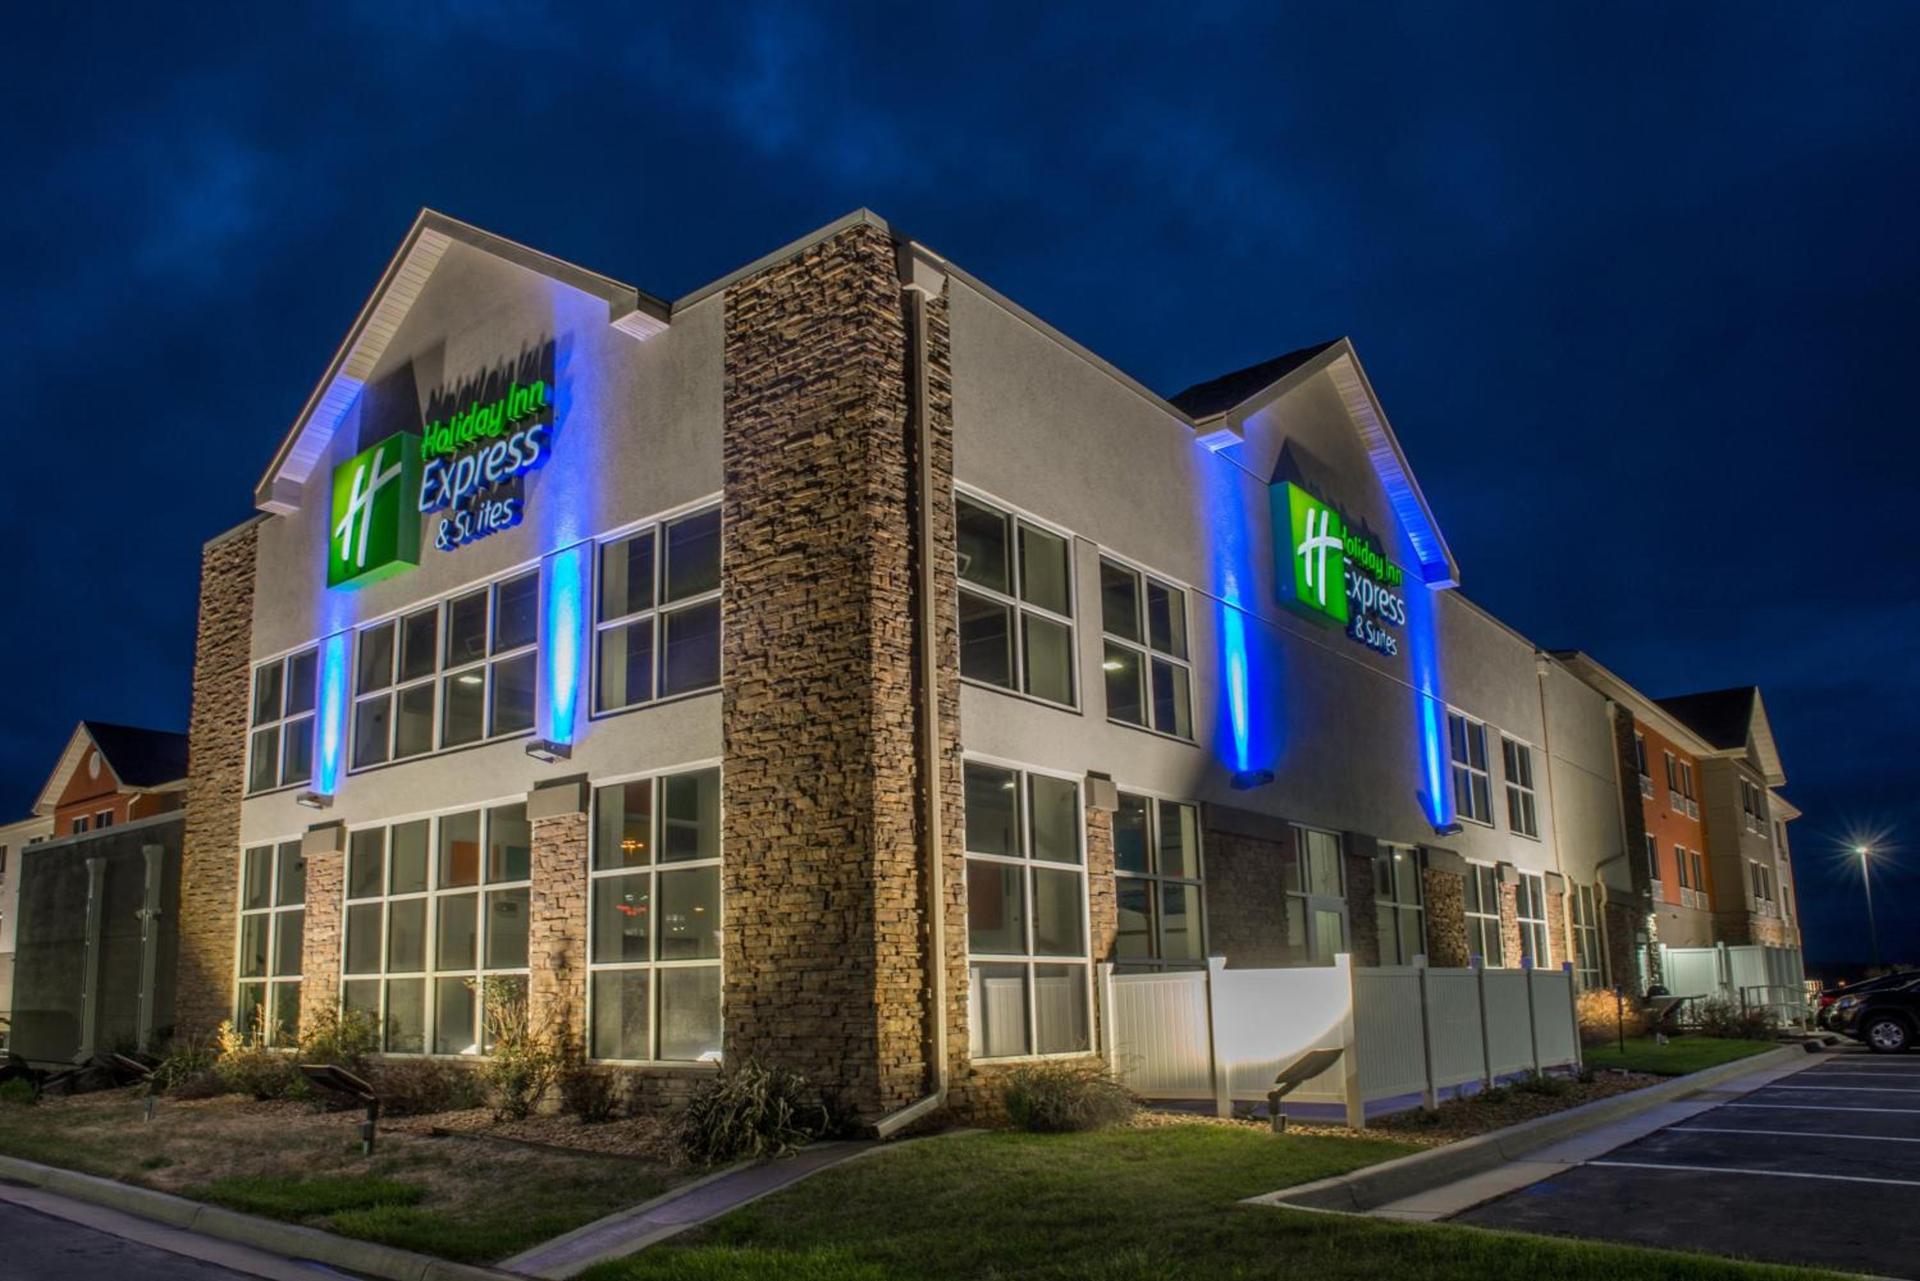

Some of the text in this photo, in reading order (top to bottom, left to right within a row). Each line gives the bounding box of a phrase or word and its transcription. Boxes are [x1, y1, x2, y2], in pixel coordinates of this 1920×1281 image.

[421, 381, 545, 461] Holiday Inn
[418, 424, 543, 512] Express
[435, 498, 514, 548] & Suites
[1355, 615, 1365, 639] &
